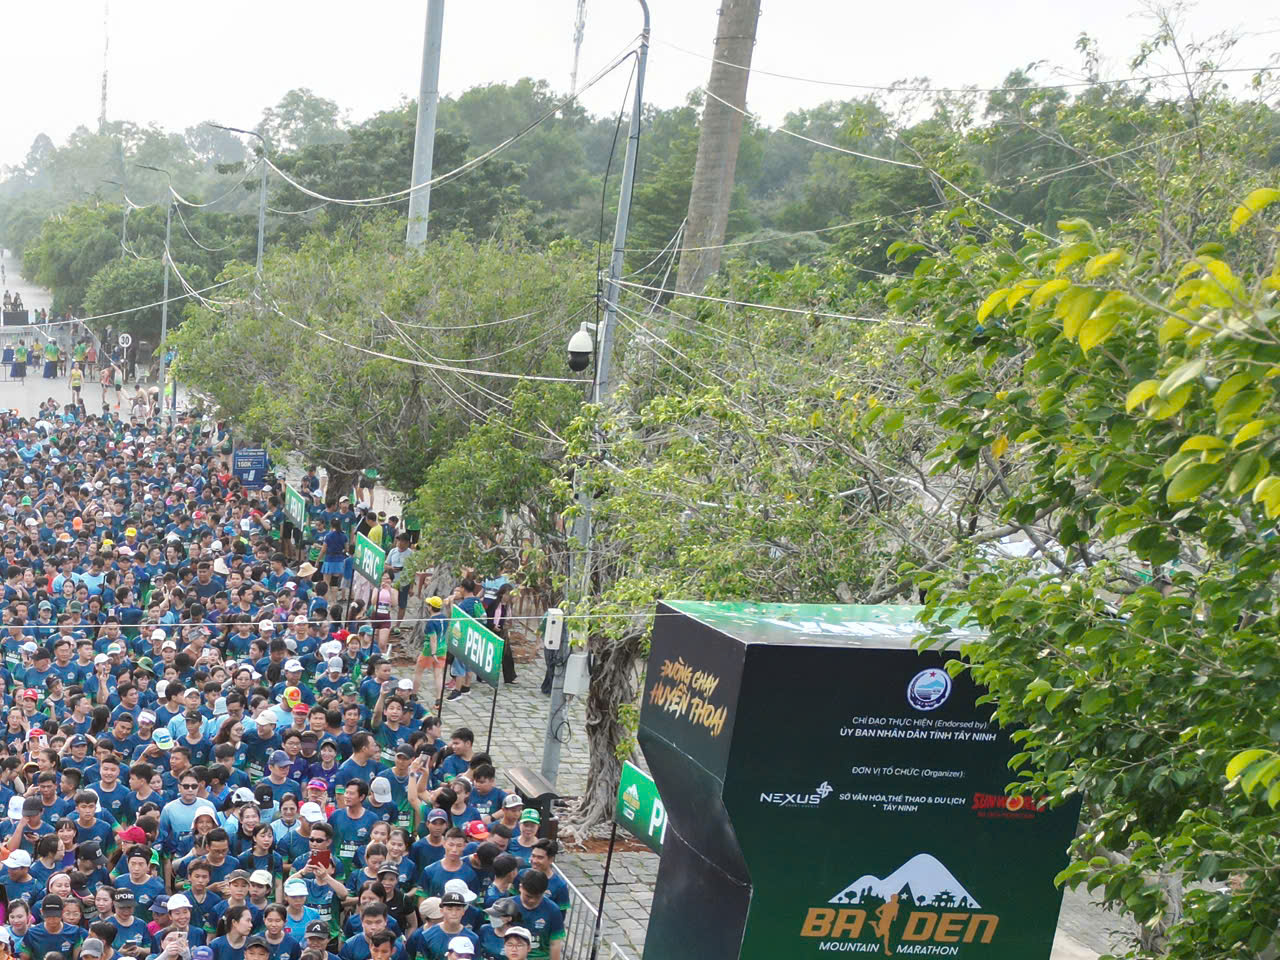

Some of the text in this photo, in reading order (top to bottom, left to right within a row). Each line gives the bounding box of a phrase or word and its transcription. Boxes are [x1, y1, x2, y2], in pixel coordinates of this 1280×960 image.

[362, 547, 380, 580] PEN C
[465, 627, 494, 673] PEN B
[934, 720, 974, 729] (Endorsed
[854, 729, 876, 737] BAN
[877, 729, 905, 739] NHÂN
[906, 729, 926, 739] DÂN
[953, 731, 971, 740] TÂY
[972, 733, 997, 741] NINH
[760, 793, 821, 806] NEXUS
[800, 907, 1000, 944] BA DEN
[818, 941, 959, 956] MOUNTAIN MARATHON
